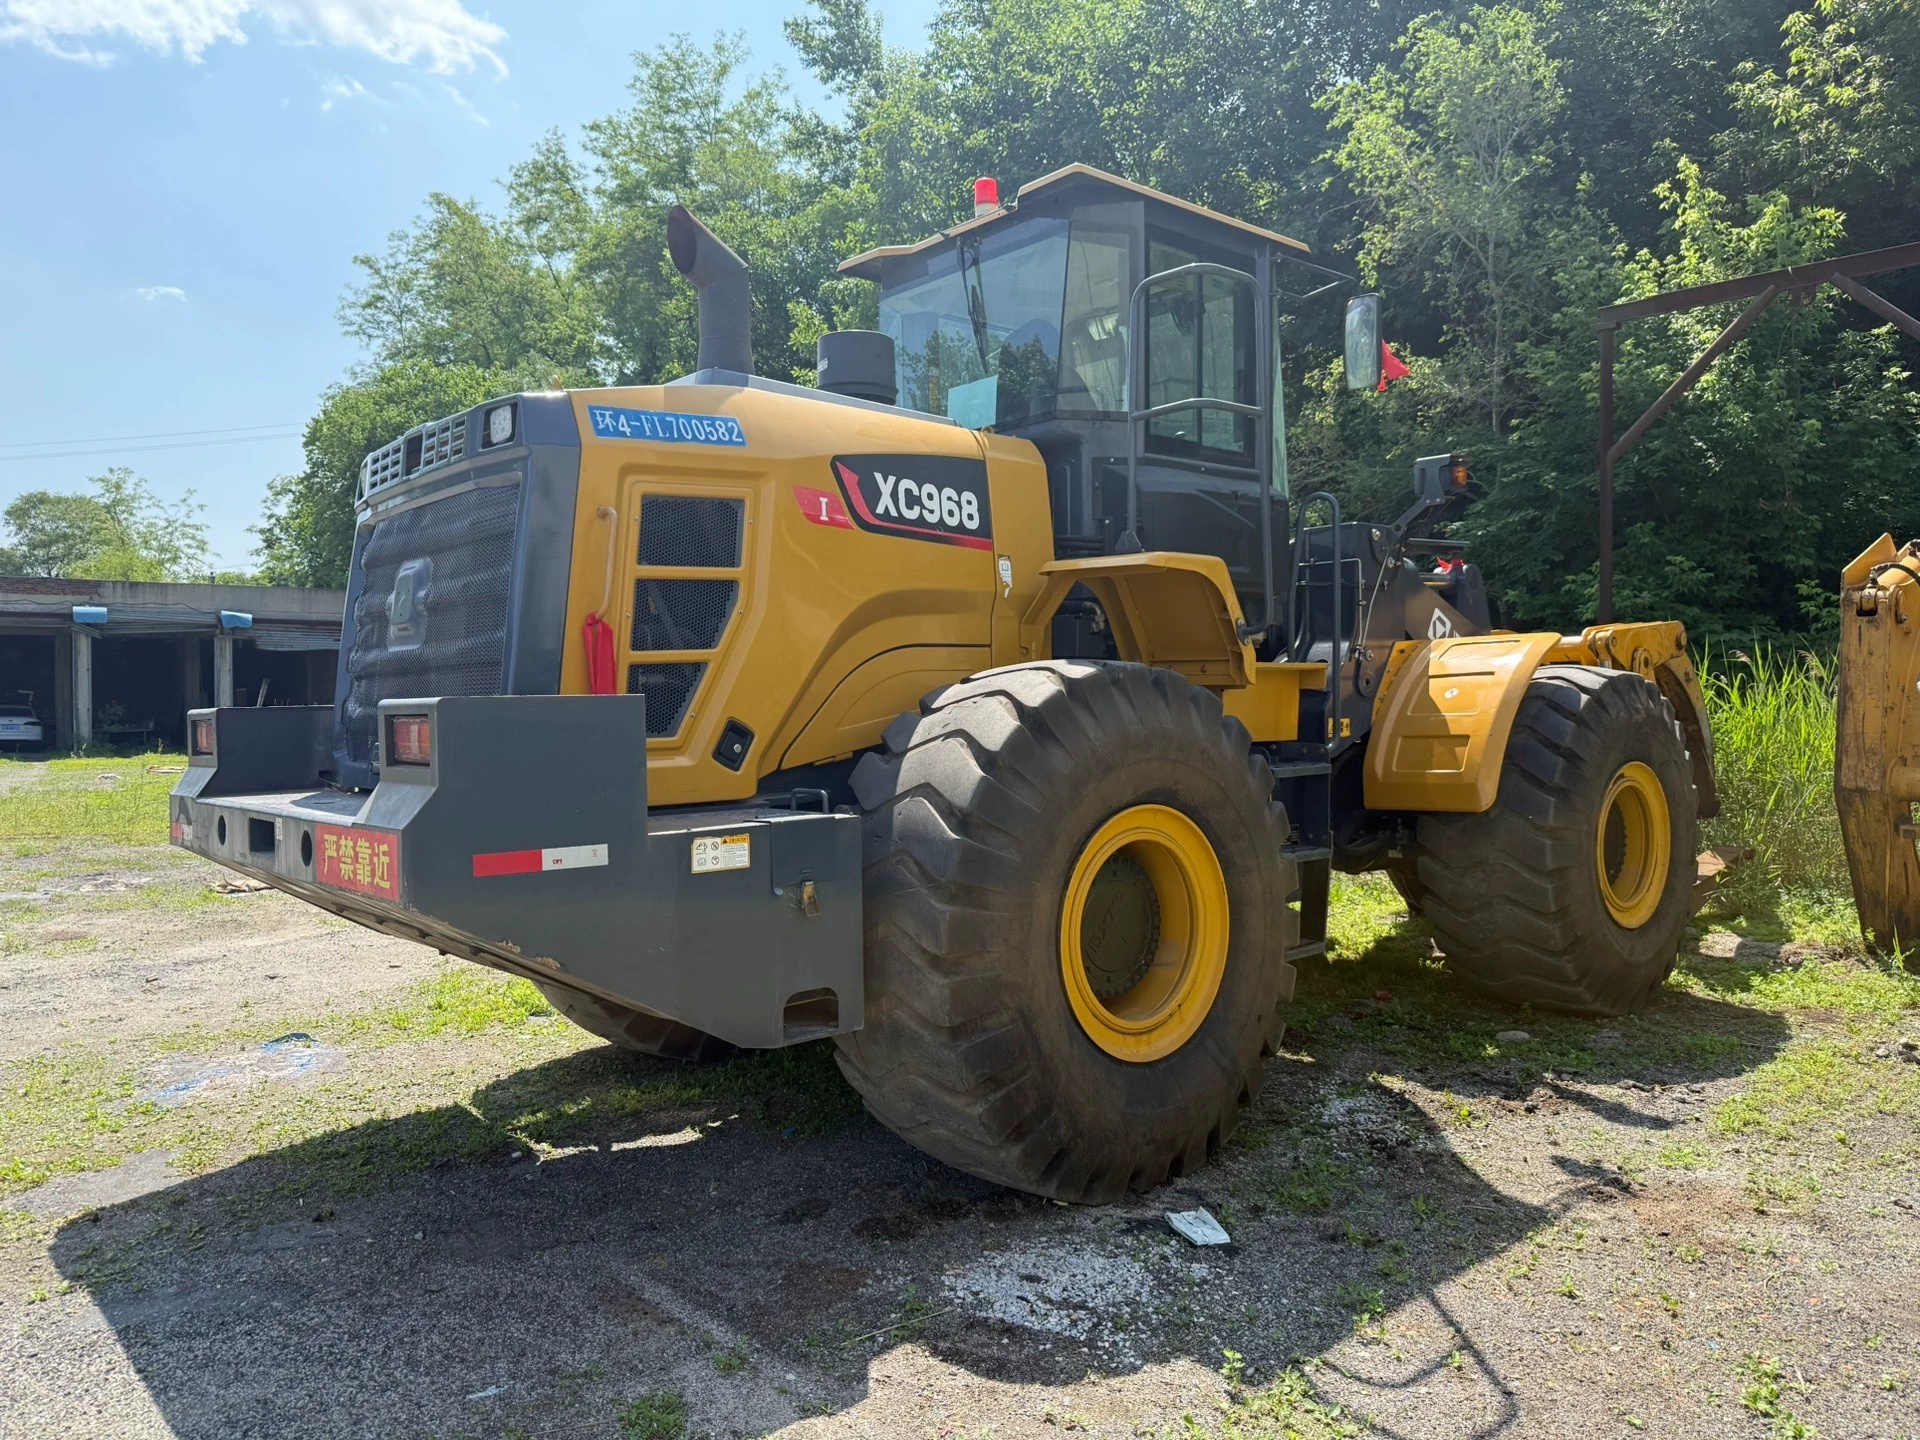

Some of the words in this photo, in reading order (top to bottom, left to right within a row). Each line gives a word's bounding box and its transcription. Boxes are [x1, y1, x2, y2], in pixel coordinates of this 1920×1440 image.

[873, 472, 980, 530] XC968
[323, 834, 391, 889] 严禁靠近
